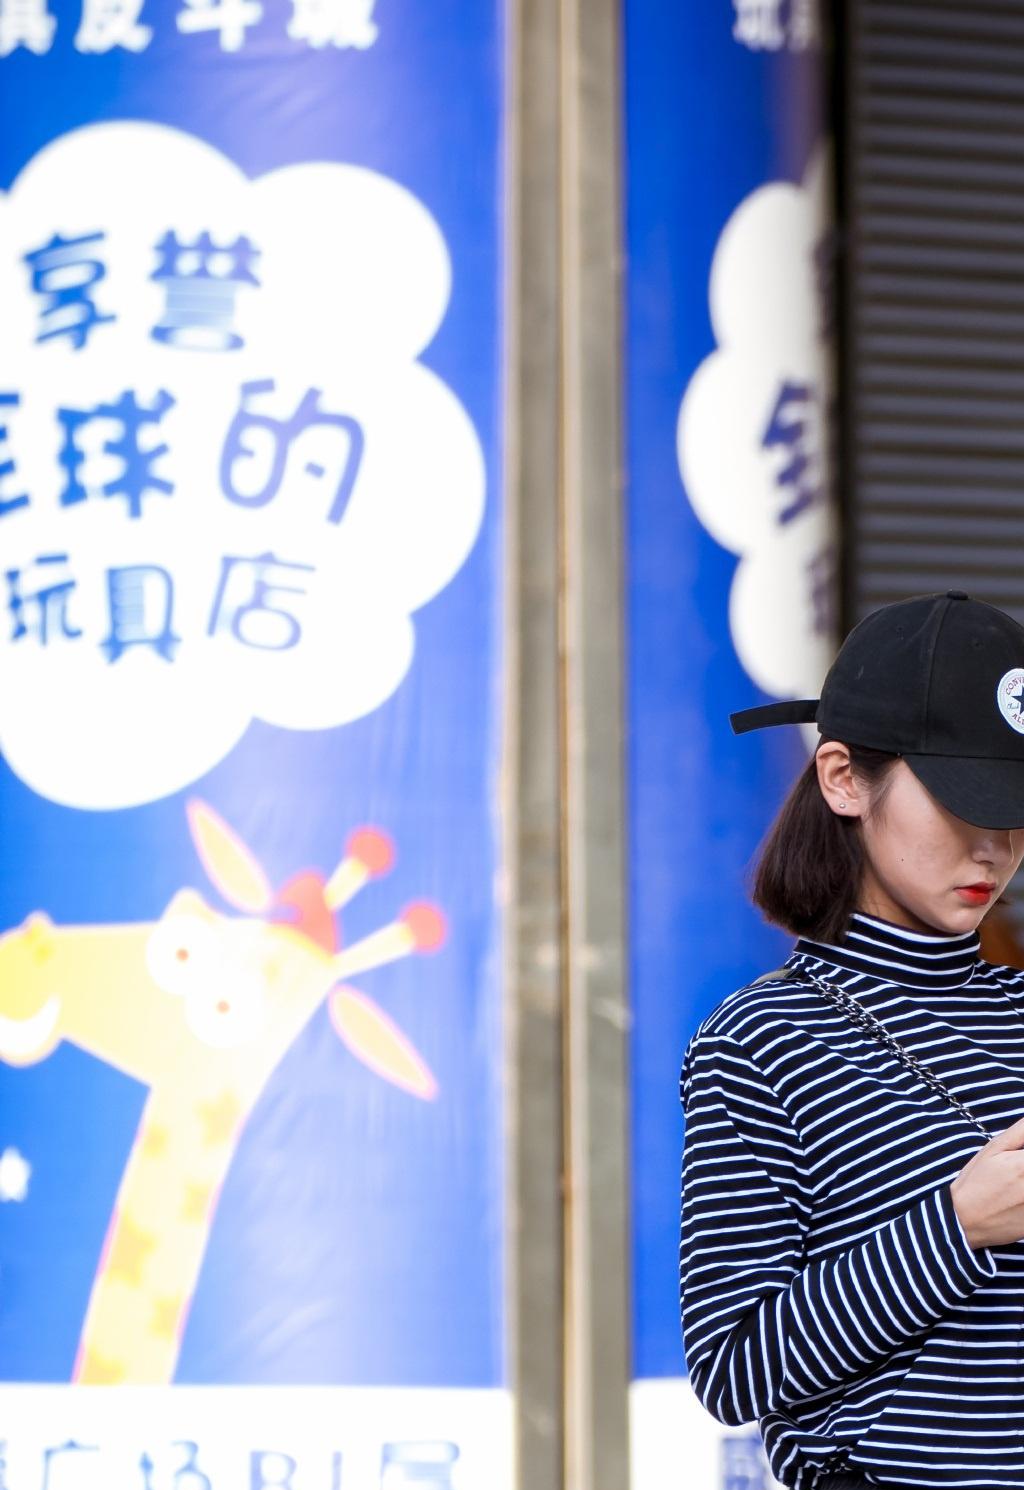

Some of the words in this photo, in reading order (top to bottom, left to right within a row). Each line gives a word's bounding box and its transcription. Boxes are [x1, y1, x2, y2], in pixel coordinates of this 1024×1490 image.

[22, 230, 262, 352] 享誉
[4, 552, 316, 664] 玩具店
